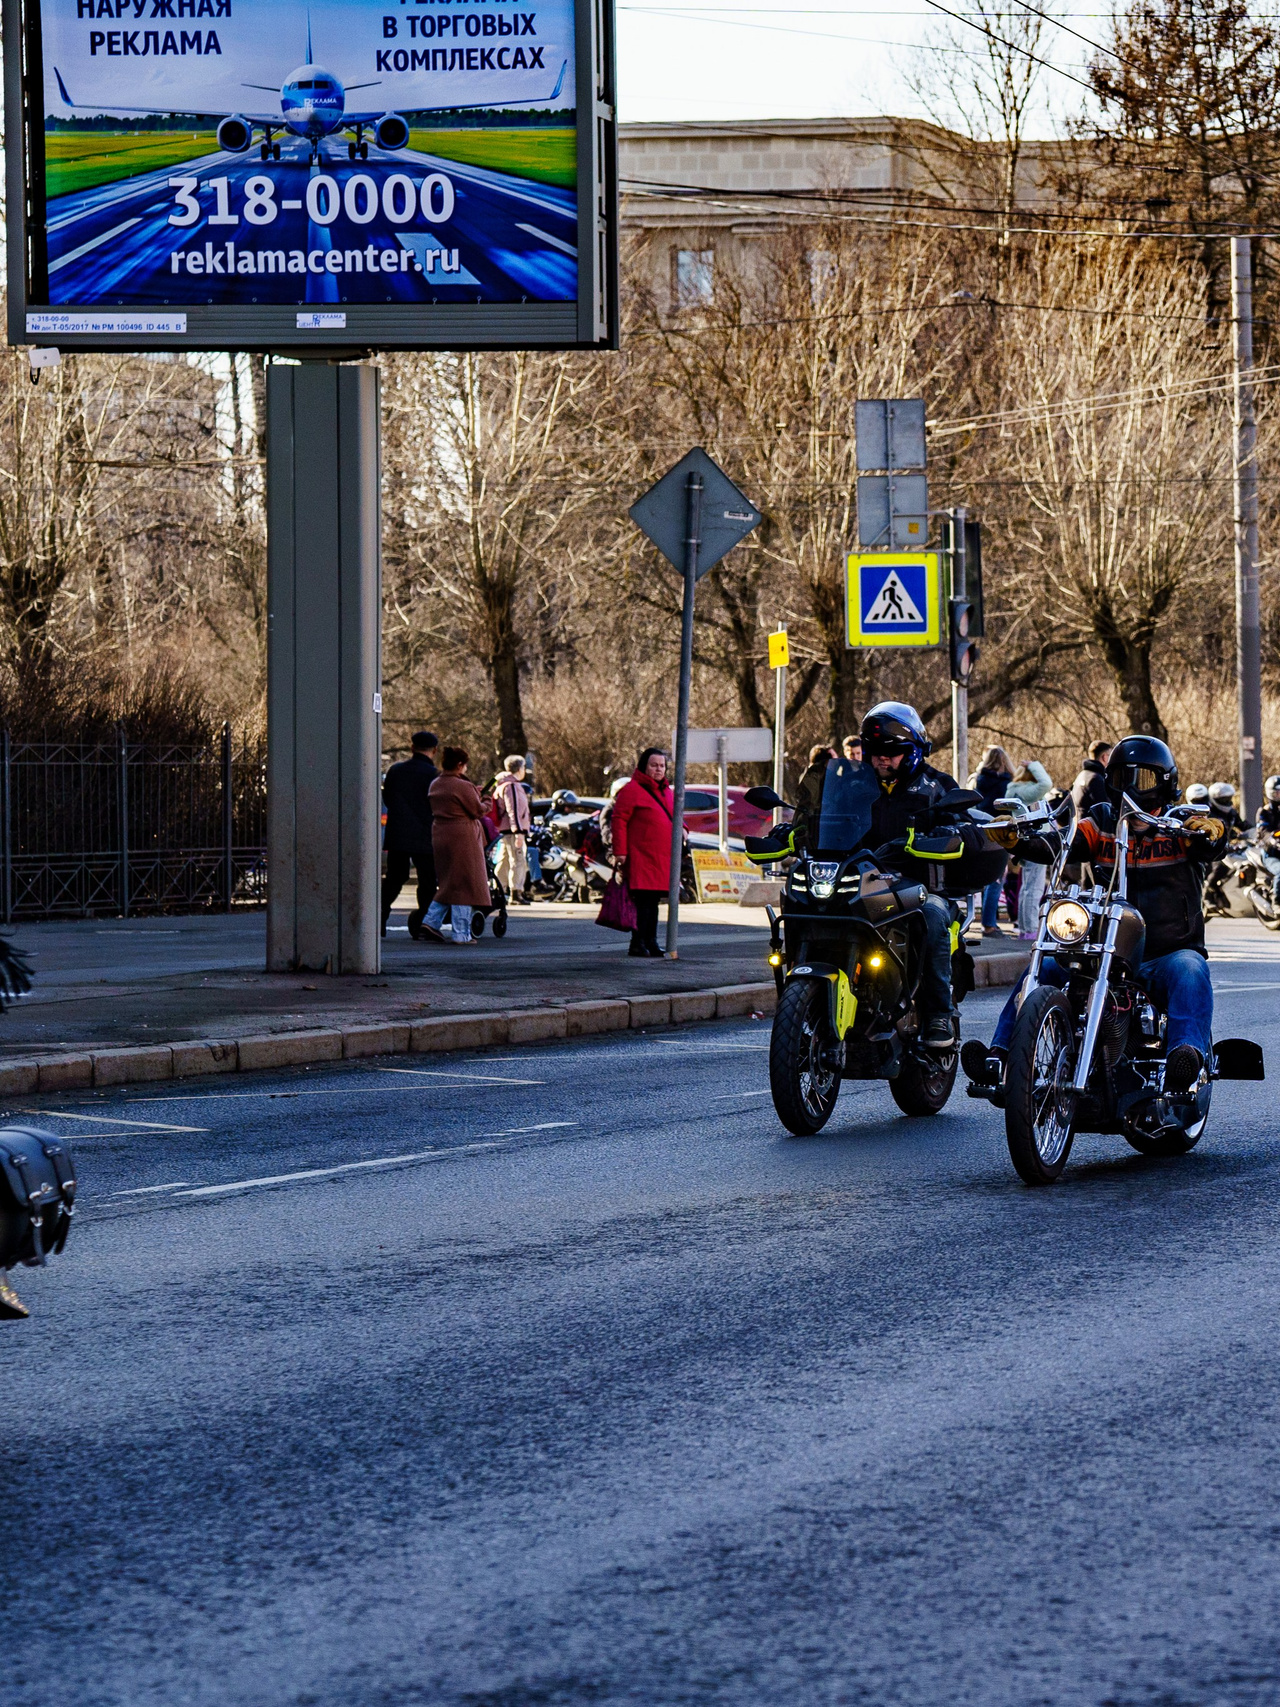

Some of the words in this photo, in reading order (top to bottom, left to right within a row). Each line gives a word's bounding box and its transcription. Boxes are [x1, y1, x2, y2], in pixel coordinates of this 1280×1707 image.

[77, 0, 232, 18] НАРУЖНАЯ
[382, 16, 398, 38] В
[406, 13, 537, 38] ТОРГОВЫХ
[90, 30, 222, 56] РЕКЛАМА
[376, 46, 545, 72] КОМПЛЕКСАХ
[167, 173, 455, 226] 318-0000
[171, 241, 460, 275] reklamacenter.ru
[37, 315, 70, 323] 318-00-00
[116, 323, 143, 331] 100496
[156, 323, 170, 331] 445
